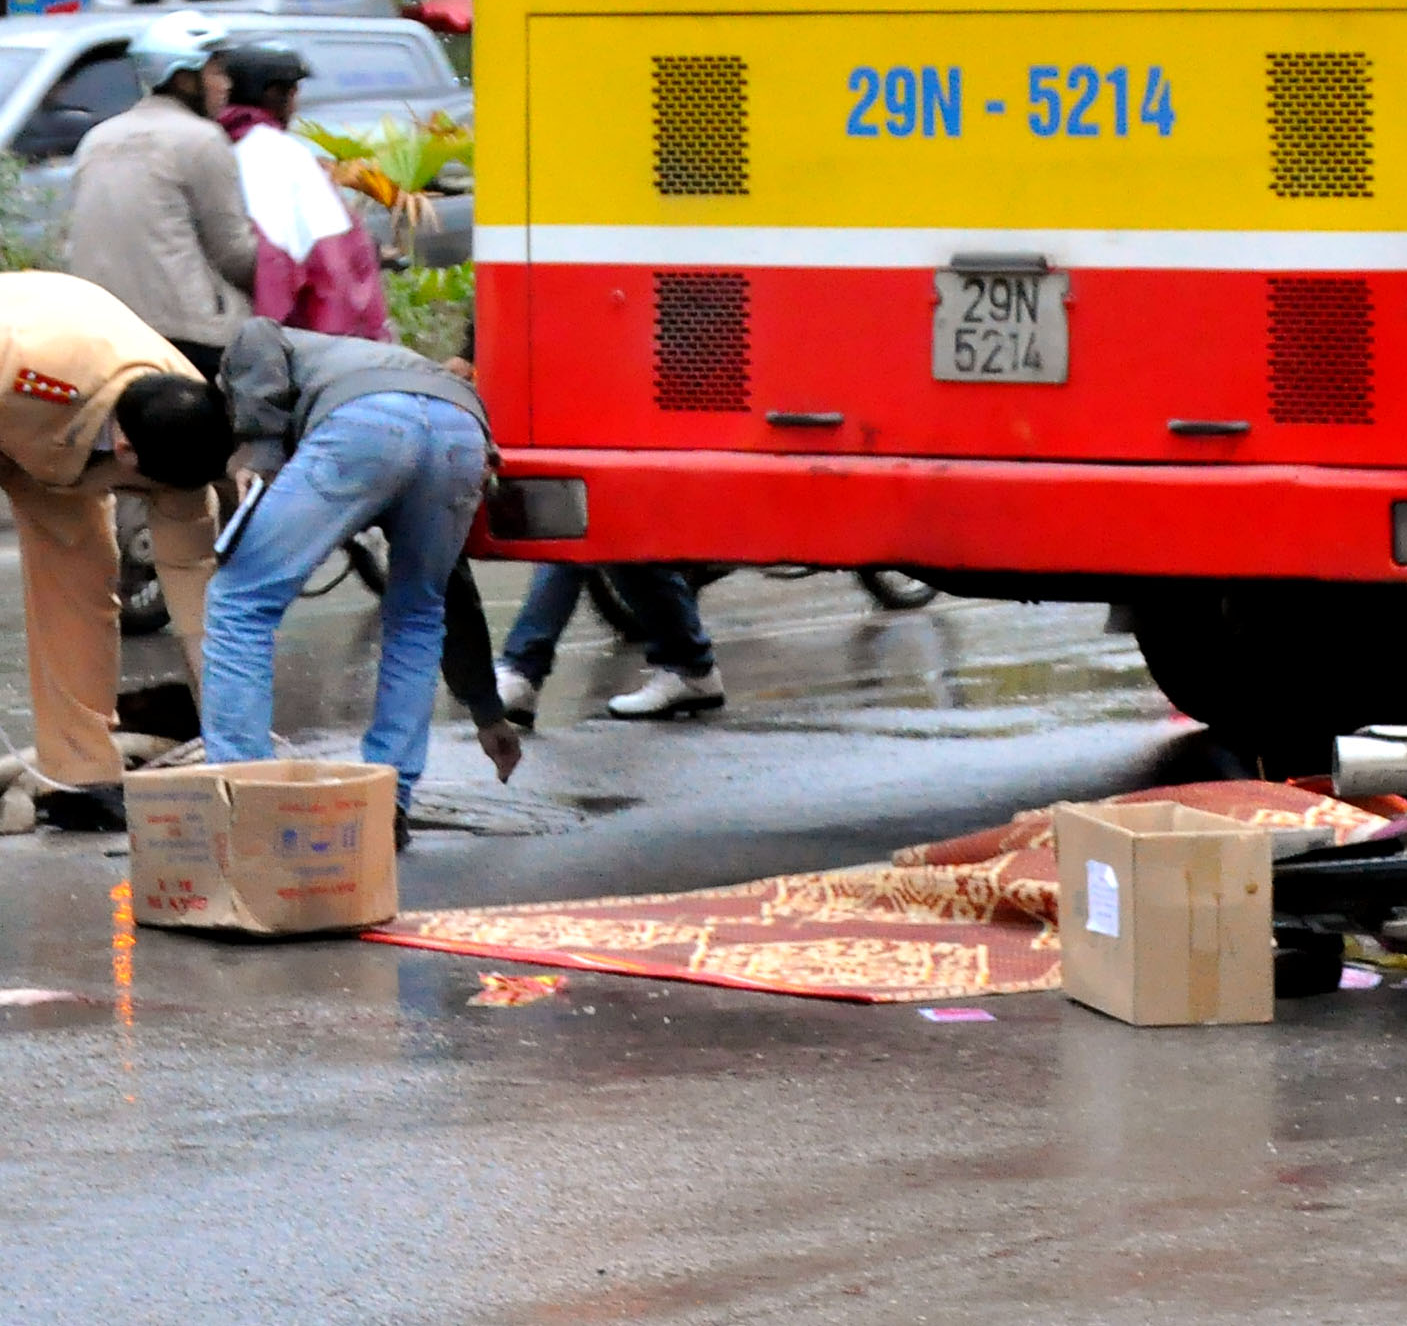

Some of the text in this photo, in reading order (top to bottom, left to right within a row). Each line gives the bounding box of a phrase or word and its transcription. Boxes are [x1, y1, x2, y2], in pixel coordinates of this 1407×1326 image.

[846, 65, 963, 138] 29N
[1027, 64, 1176, 138] 5214
[962, 276, 1039, 323] 29N
[953, 328, 1043, 374] 5214
